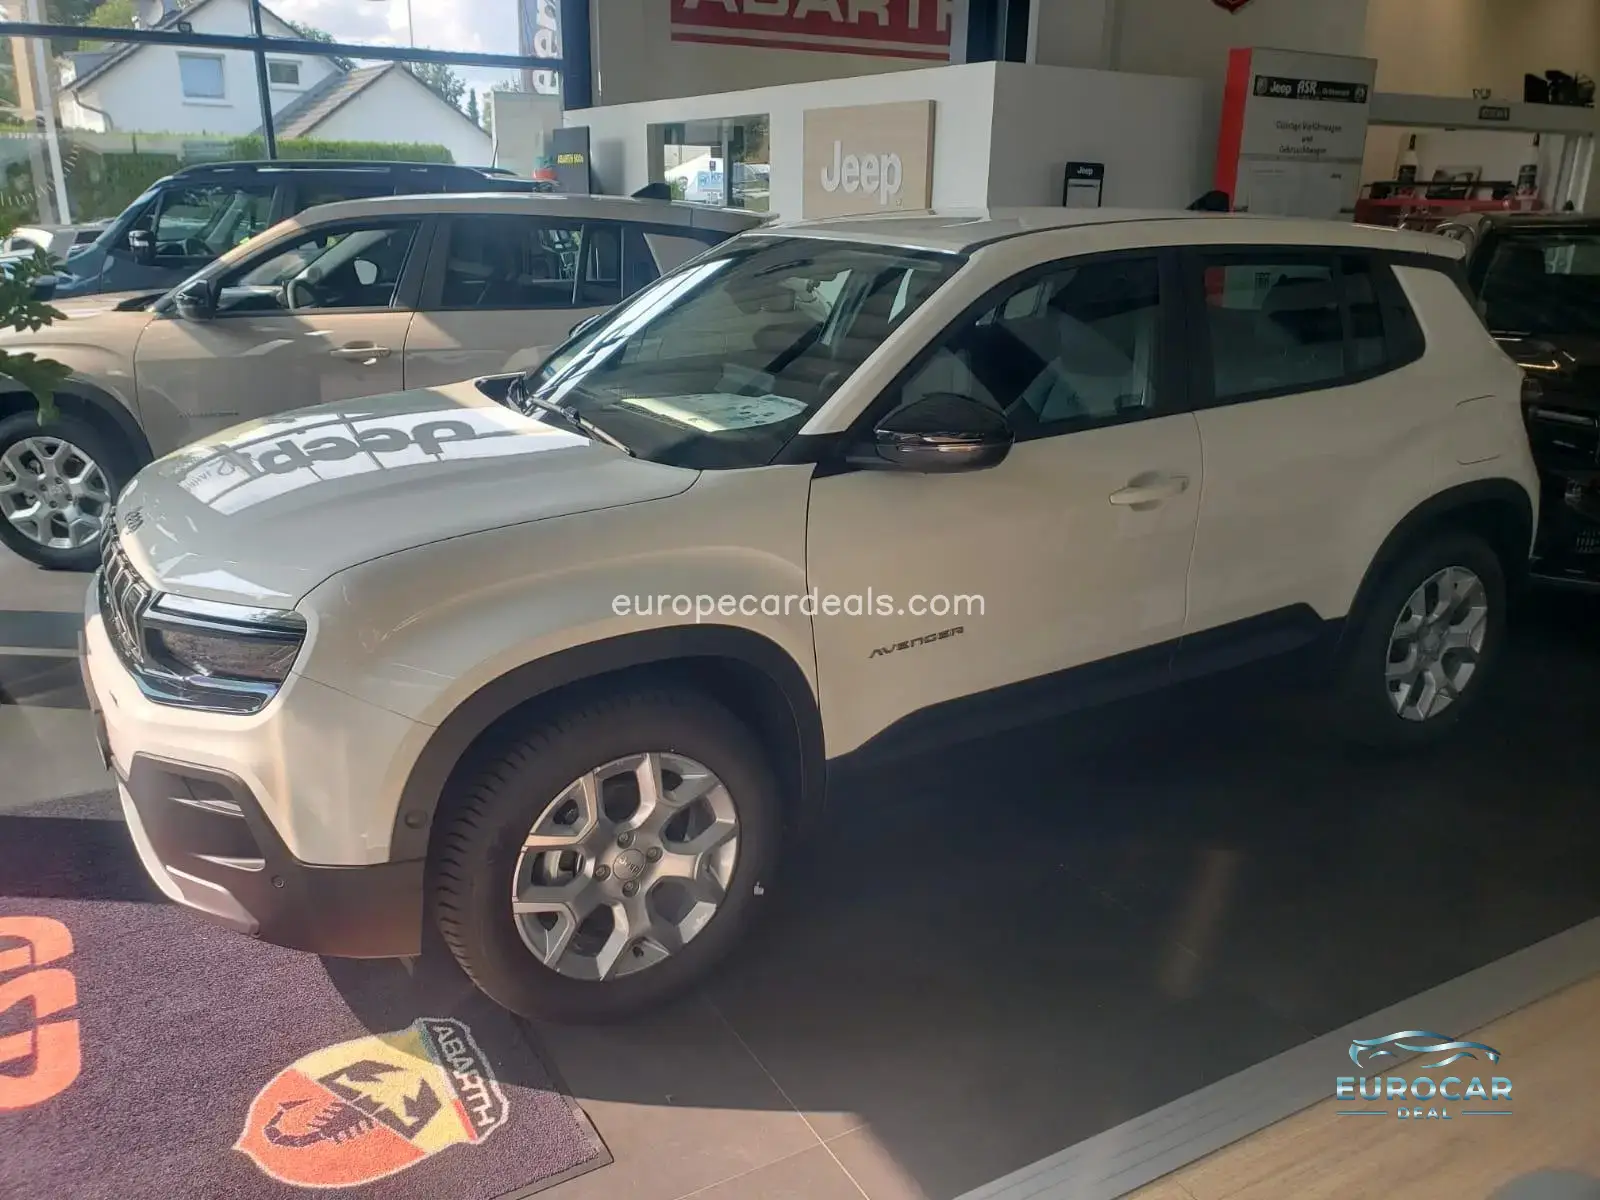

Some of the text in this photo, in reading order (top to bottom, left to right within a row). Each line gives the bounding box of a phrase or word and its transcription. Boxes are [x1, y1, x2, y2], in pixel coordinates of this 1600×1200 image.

[683, 0, 951, 31] ART
[1269, 81, 1292, 95] Jeep
[820, 140, 902, 205] Jeep
[868, 626, 965, 658] AVENGER
[431, 1025, 496, 1127] ABARTH
